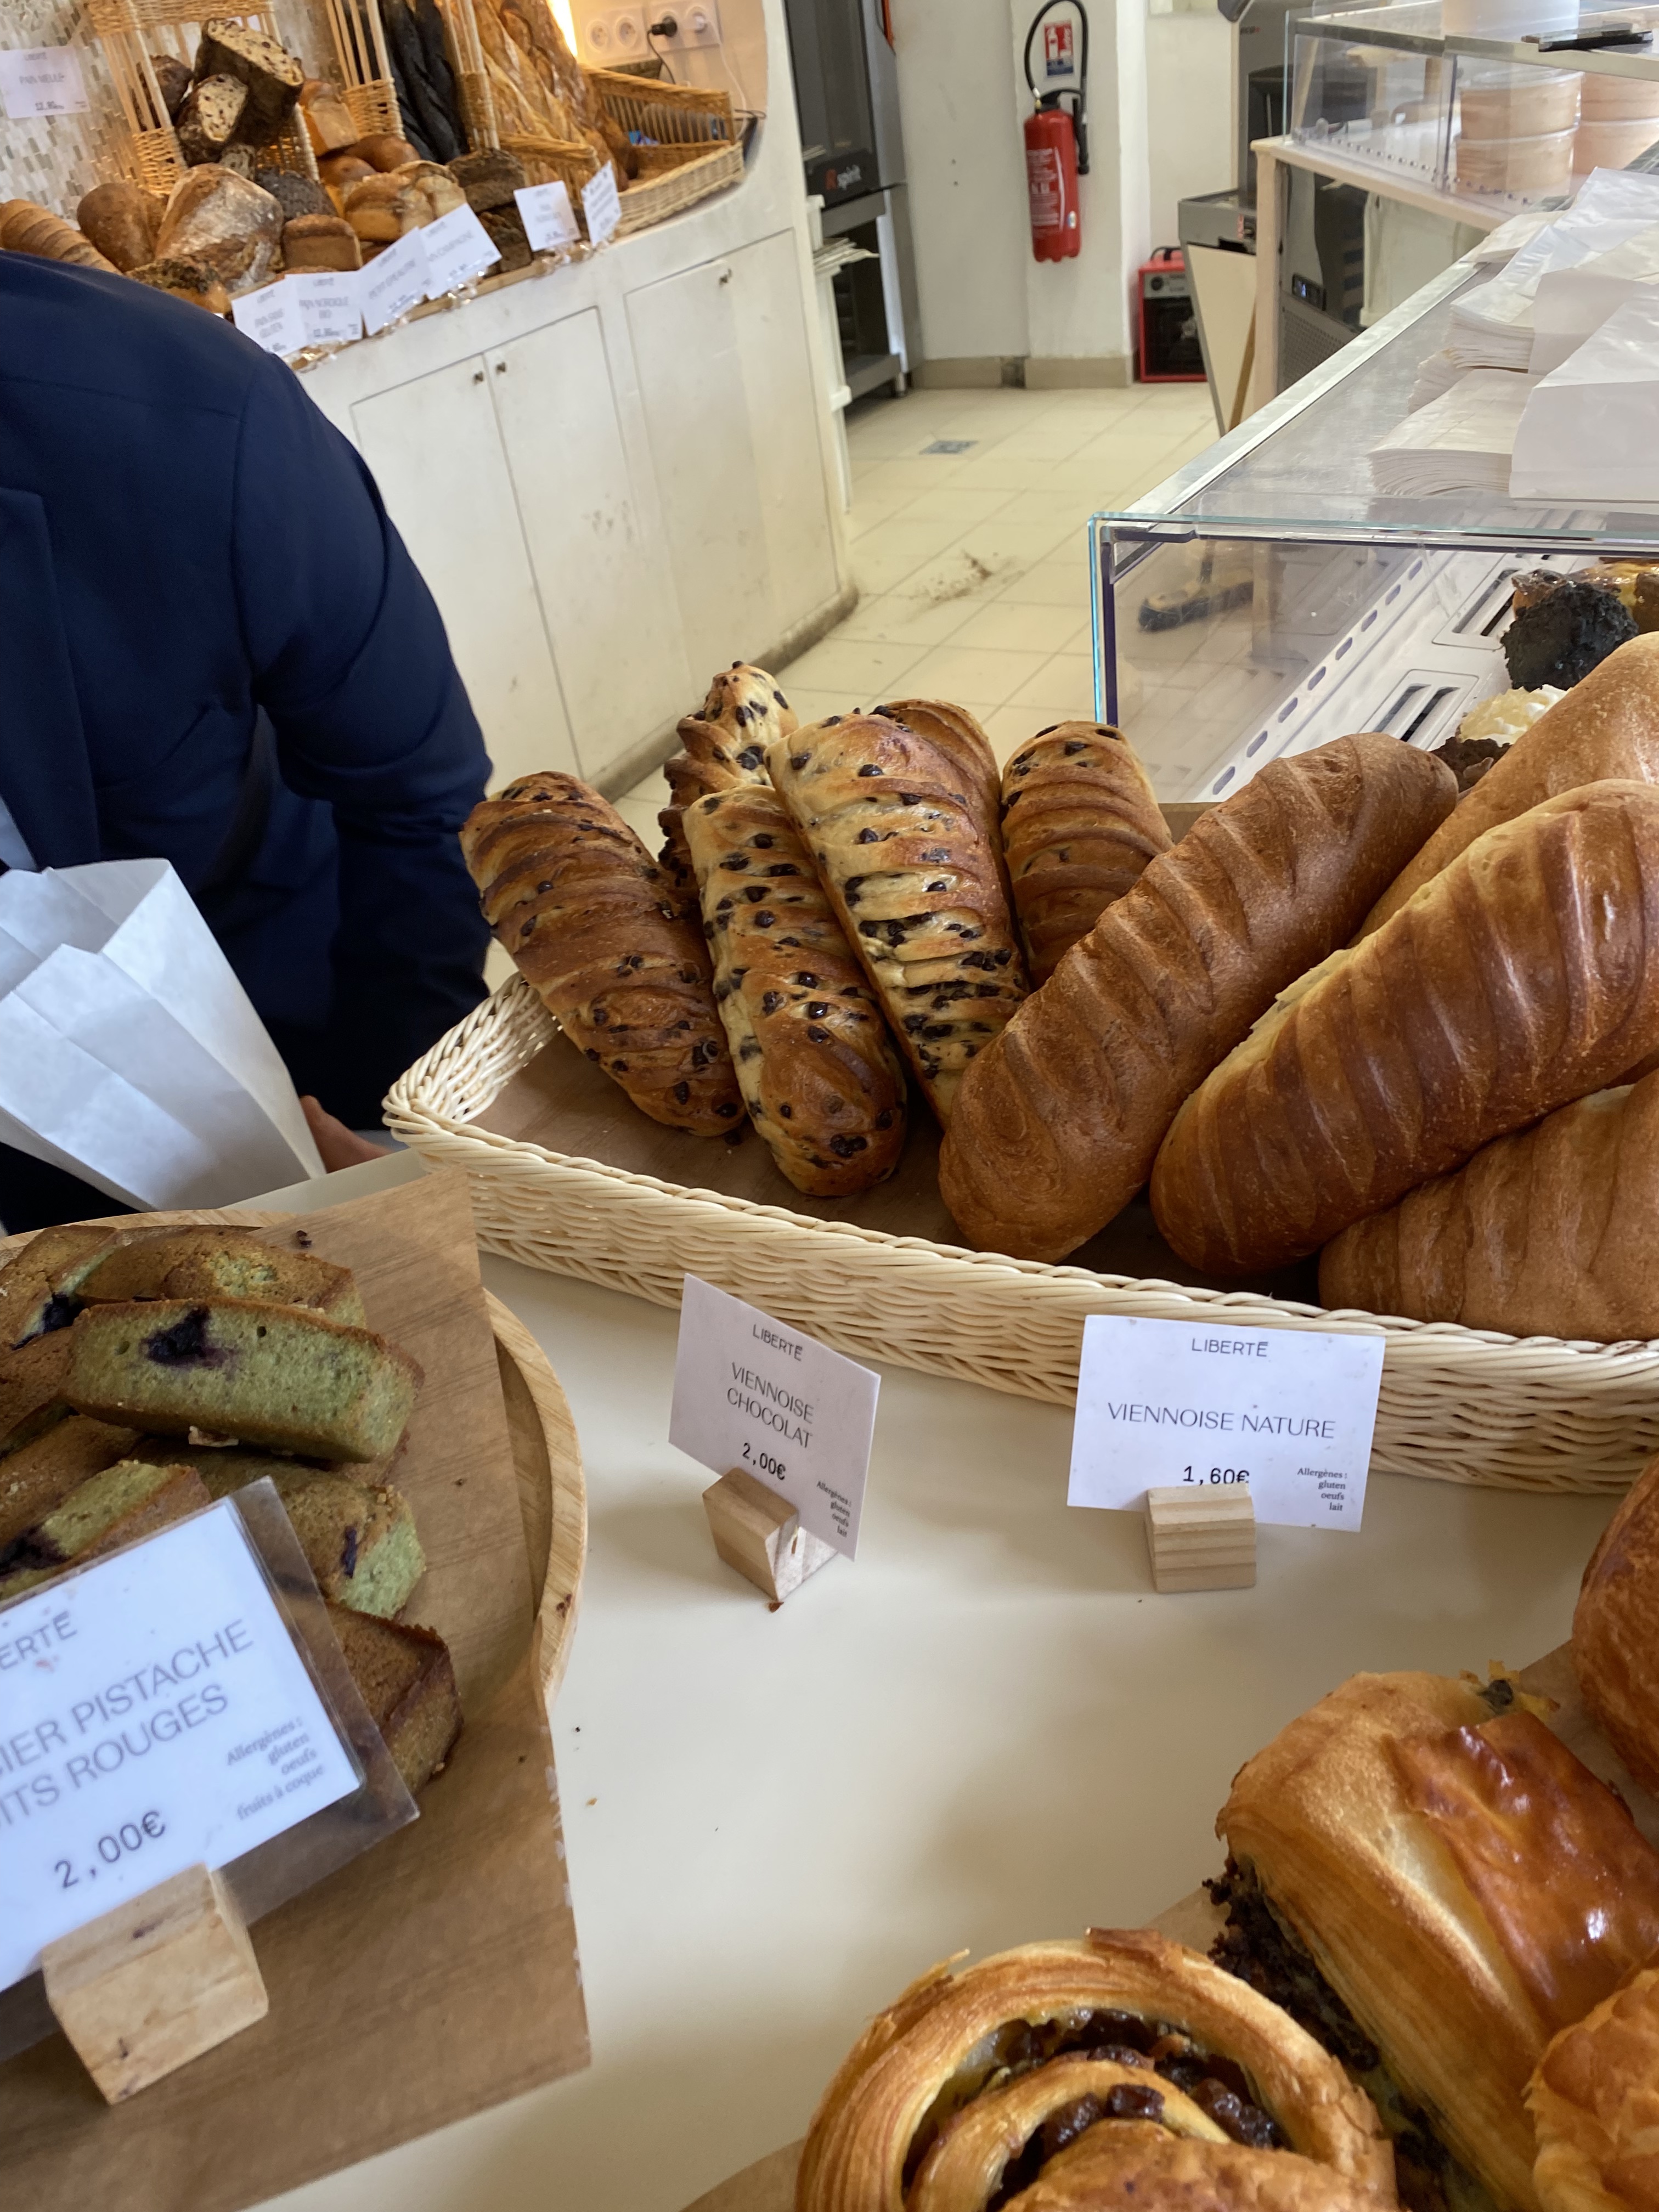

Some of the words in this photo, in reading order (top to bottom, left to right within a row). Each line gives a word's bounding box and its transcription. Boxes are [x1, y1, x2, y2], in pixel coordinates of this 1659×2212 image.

[731, 1362, 815, 1424] VIENNOISE
[727, 1387, 813, 1448] CHOCOLAT
[1107, 1402, 1235, 1431] VIENNOISE
[1241, 1414, 1336, 1440] NATURE
[742, 1442, 786, 1481] 2,00€
[1183, 1465, 1250, 1486] 1,60€
[1297, 1468, 1343, 1479] Allergènes
[1318, 1480, 1346, 1490] gluten
[831, 1502, 850, 1517] gluten
[1329, 1502, 1343, 1511] lait
[837, 1525, 847, 1537] lait
[0, 1611, 78, 1671] ERTÉ
[0, 1719, 67, 1778] IER
[71, 1618, 255, 1734] PISTACHE
[0, 1773, 61, 1826] ITS
[66, 1684, 229, 1790] ROUGES
[268, 1733, 310, 1765] gluten
[285, 1764, 325, 1793] coque
[54, 1811, 166, 1888] 2,00€
